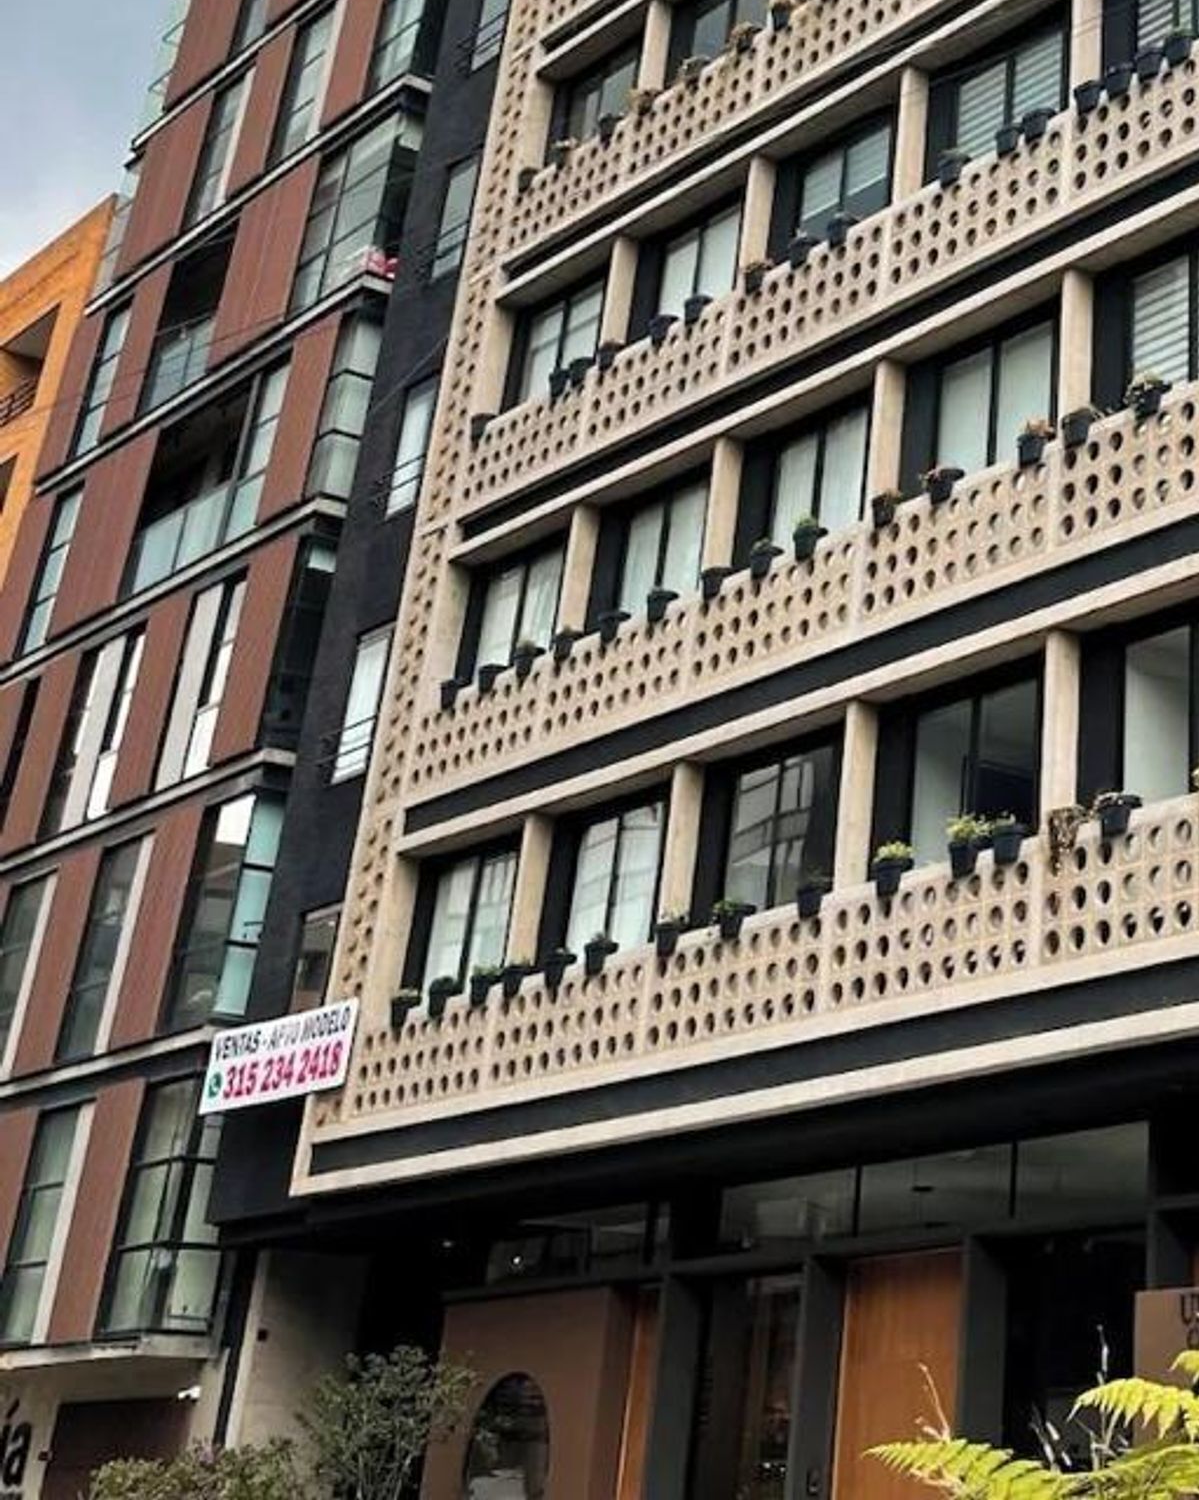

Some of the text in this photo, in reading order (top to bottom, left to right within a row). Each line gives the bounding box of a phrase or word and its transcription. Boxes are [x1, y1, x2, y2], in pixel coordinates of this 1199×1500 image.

[215, 1030, 261, 1060] VENTAS
[301, 1006, 350, 1042] MODELO
[223, 1039, 343, 1099] 315 234 2418
